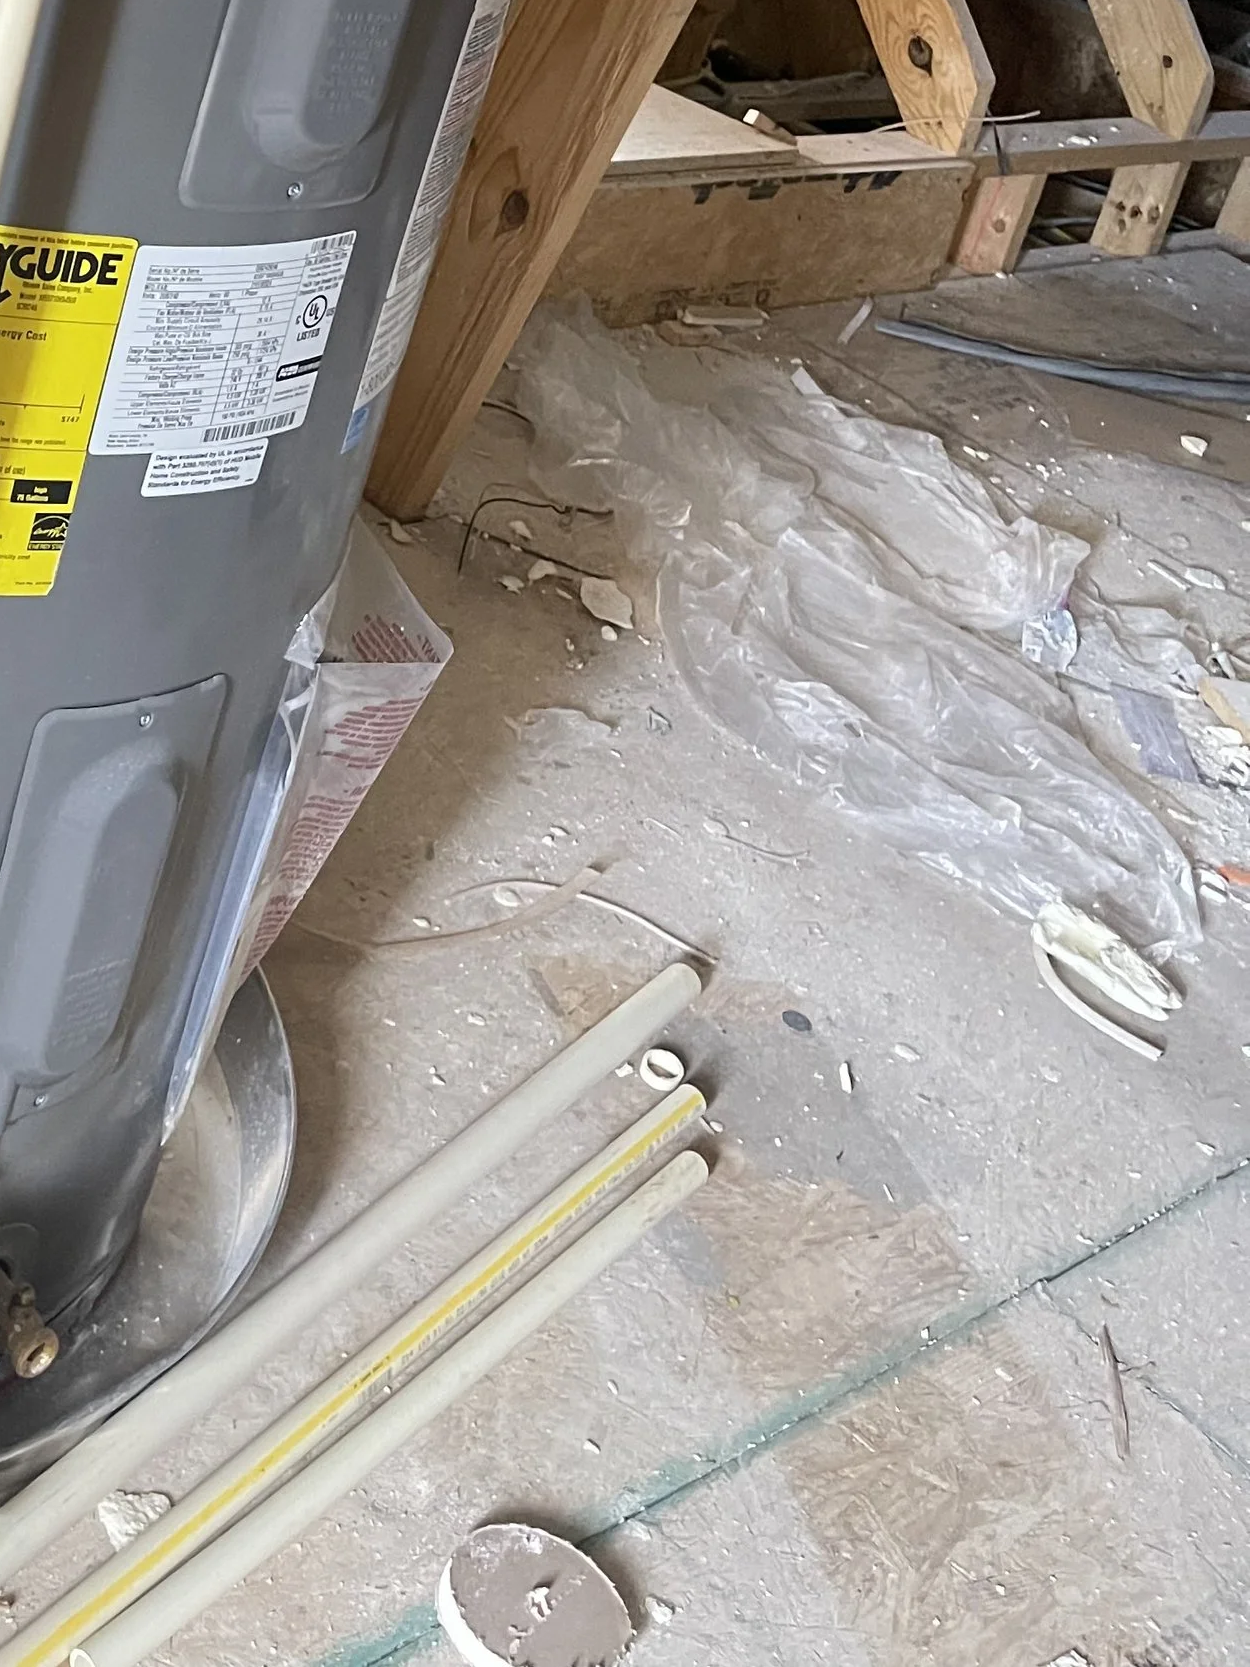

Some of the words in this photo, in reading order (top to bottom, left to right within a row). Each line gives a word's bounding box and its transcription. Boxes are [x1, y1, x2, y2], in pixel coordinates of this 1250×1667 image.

[307, 302, 322, 320] UL
[25, 330, 47, 340] Cost
[295, 328, 320, 341] LISTED
[154, 452, 178, 462] Design
[178, 451, 208, 461] evaluated
[233, 445, 264, 454] accordance
[167, 461, 180, 469] Part
[149, 471, 168, 479] Home
[169, 467, 209, 479] Construction
[222, 465, 239, 473] Safety
[147, 478, 180, 489] Standards
[189, 476, 212, 487] Energy
